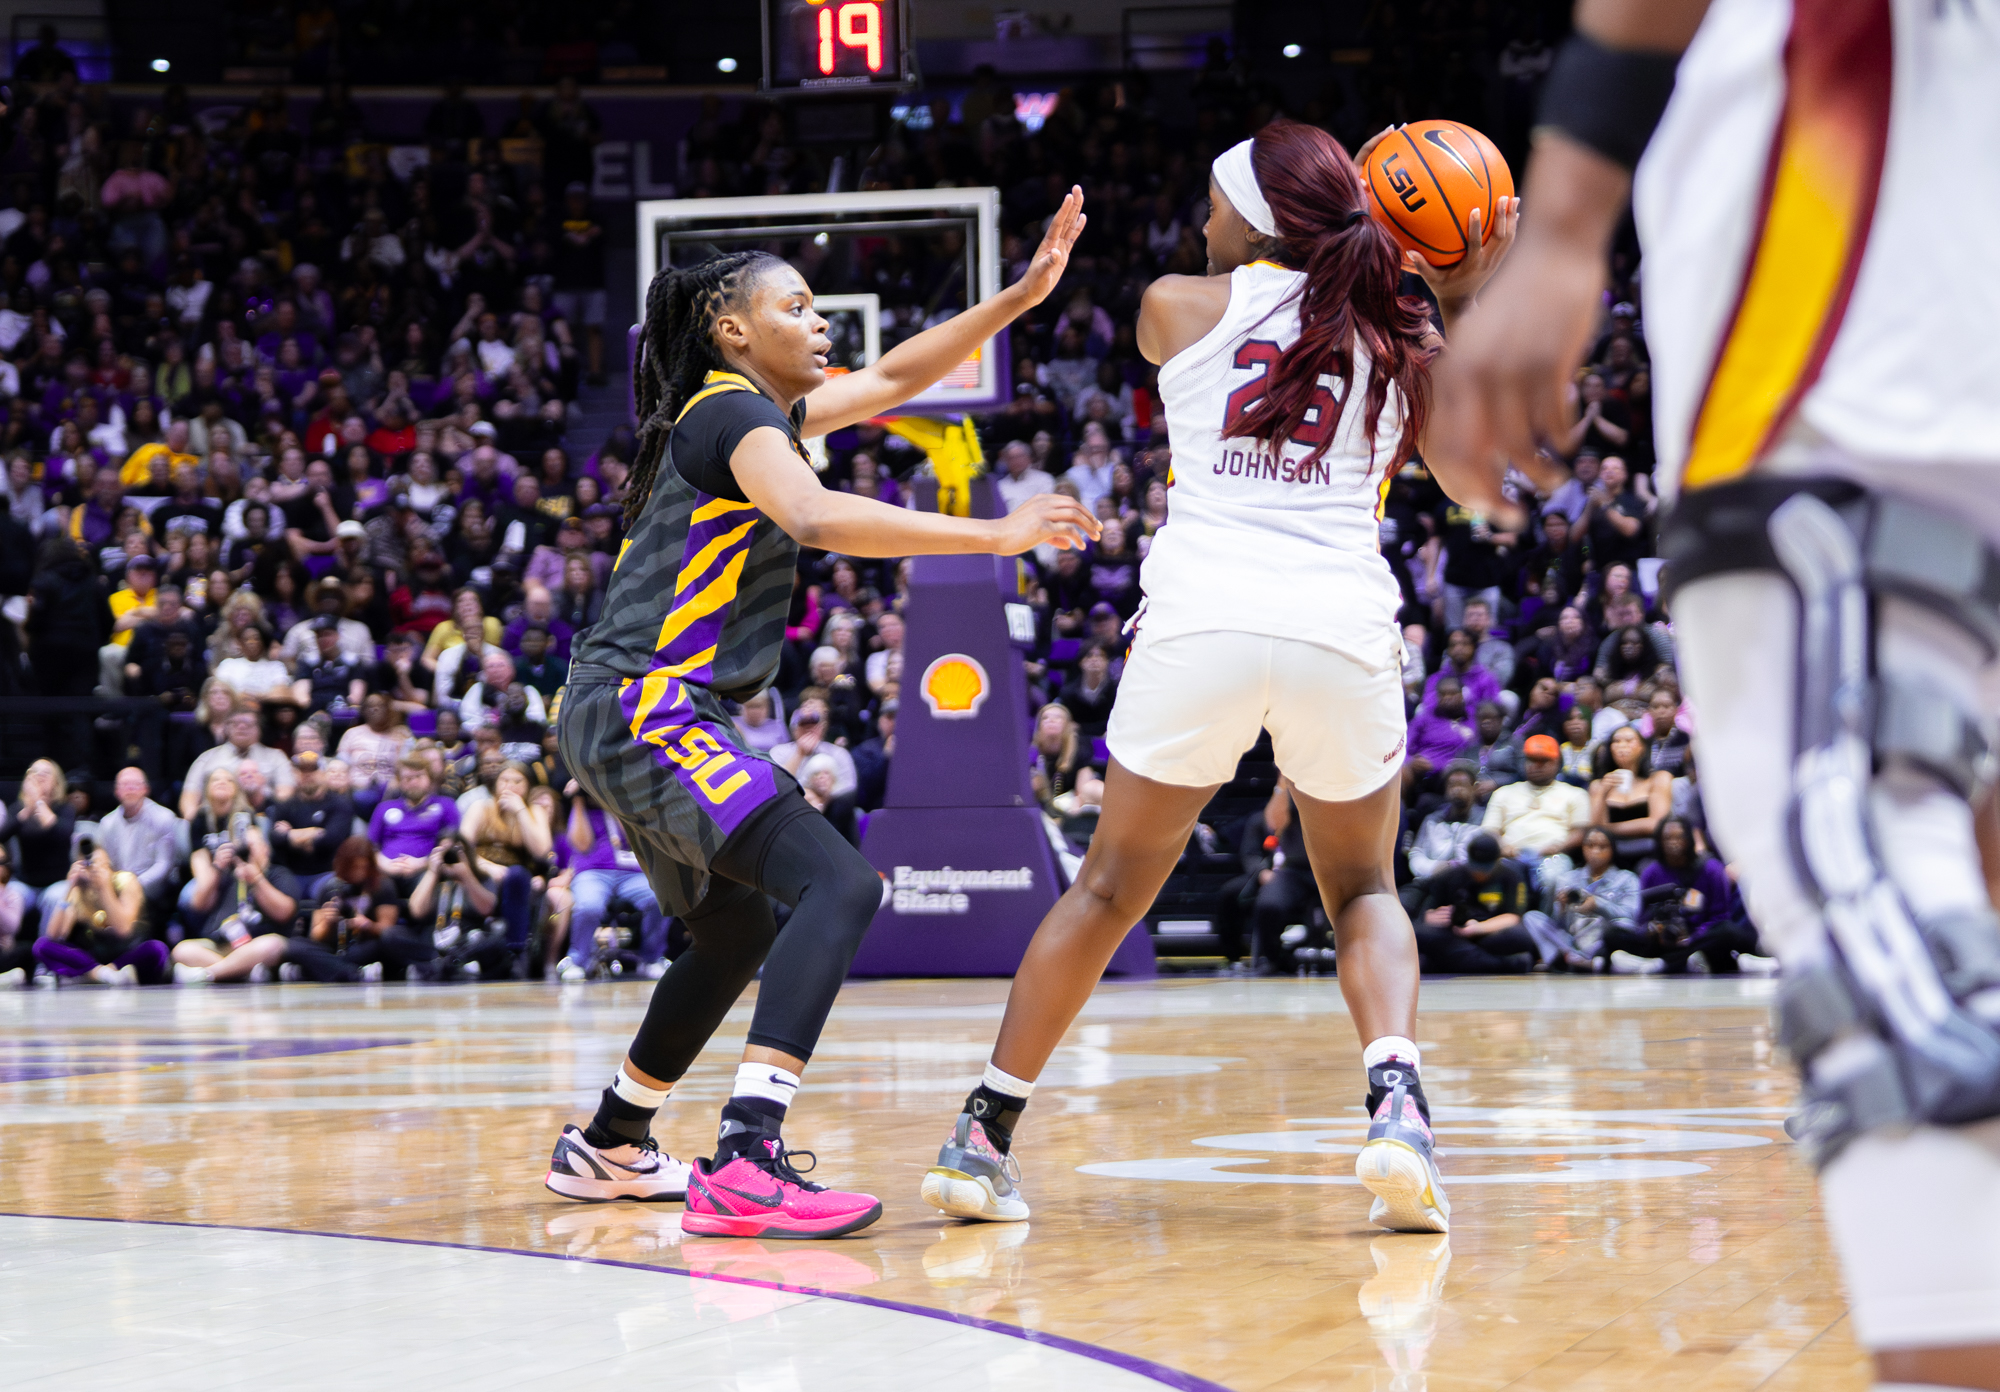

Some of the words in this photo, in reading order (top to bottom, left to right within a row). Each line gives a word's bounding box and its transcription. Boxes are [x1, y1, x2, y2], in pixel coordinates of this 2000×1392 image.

[818, 2, 883, 75] 19
[1381, 152, 1427, 213] LSU
[1213, 449, 1331, 485] JOHNSON
[641, 725, 752, 805] LSU
[892, 889, 970, 915] Share
[893, 865, 1034, 894] Equipment
